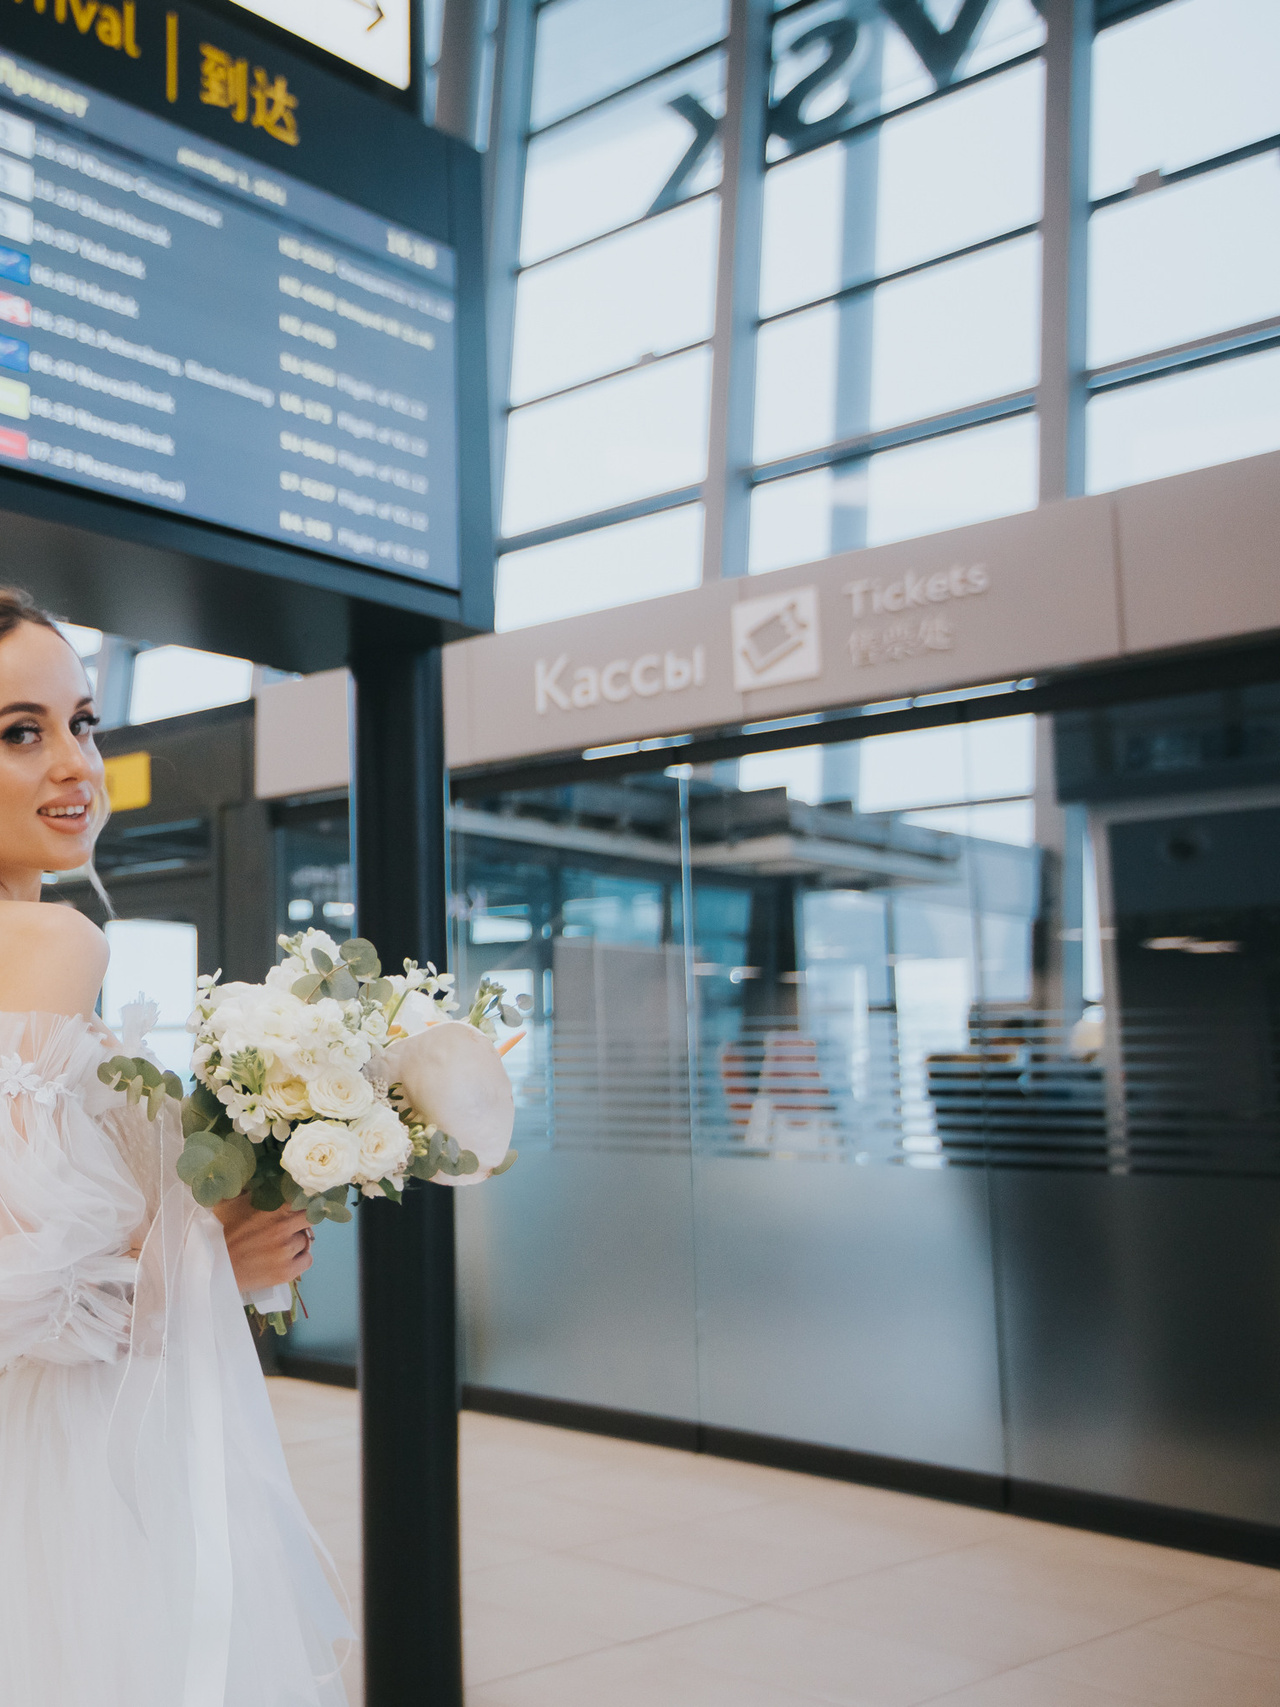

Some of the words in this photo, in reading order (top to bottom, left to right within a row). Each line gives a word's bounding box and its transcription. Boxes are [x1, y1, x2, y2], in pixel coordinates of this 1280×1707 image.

[15, 0, 142, 60] rival
[199, 42, 301, 148] 到达
[843, 562, 991, 621] Tickets
[534, 643, 708, 717] Кассы
